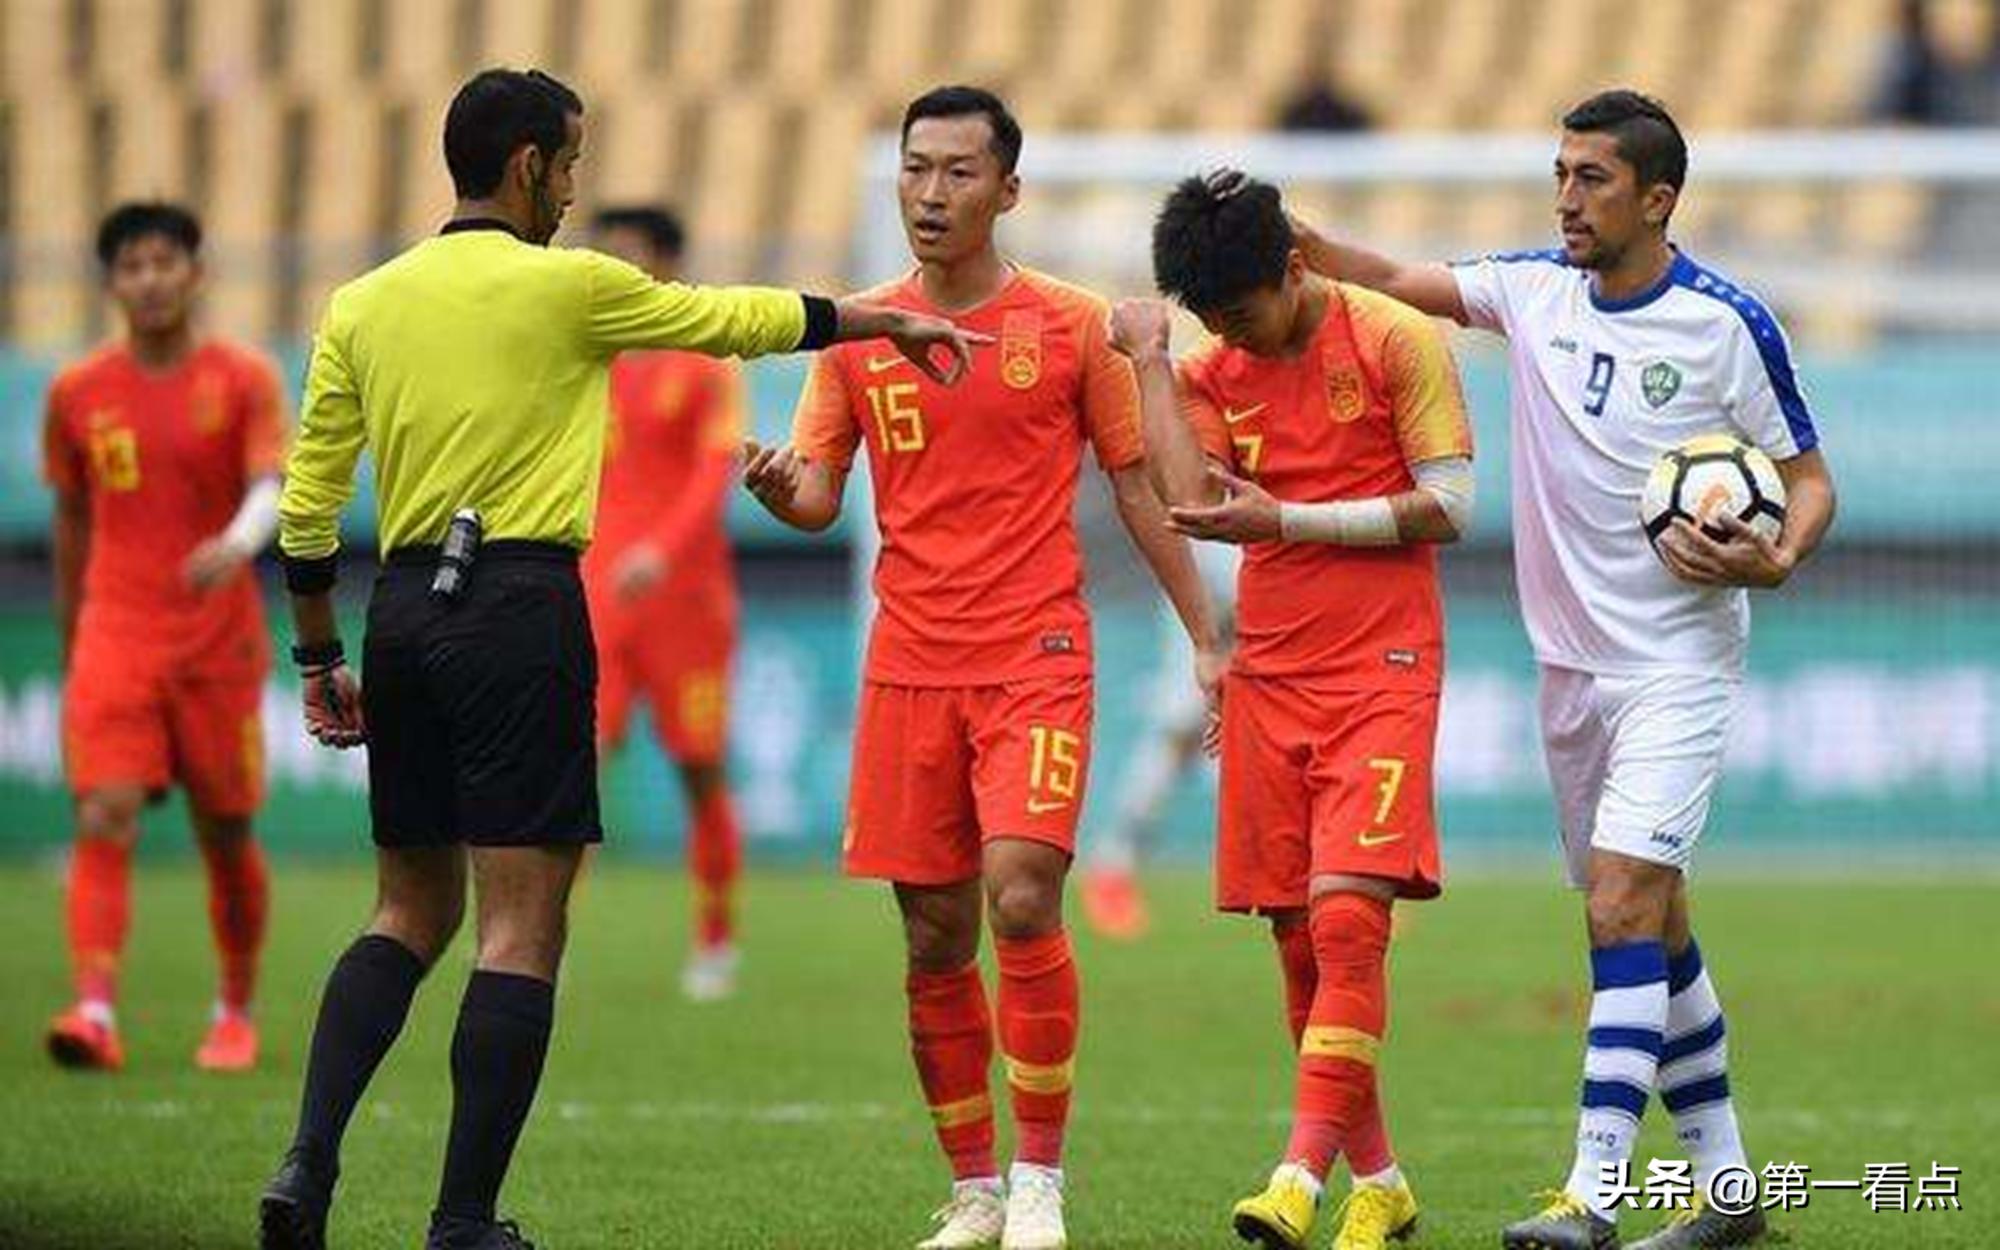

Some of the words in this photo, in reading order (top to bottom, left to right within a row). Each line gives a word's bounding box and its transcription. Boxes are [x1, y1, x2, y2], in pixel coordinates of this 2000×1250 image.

[866, 382, 925, 452] 15
[1584, 352, 1615, 417] 9
[1233, 434, 1263, 473] 7
[1028, 726, 1080, 797] 15
[1368, 758, 1405, 824] 7
